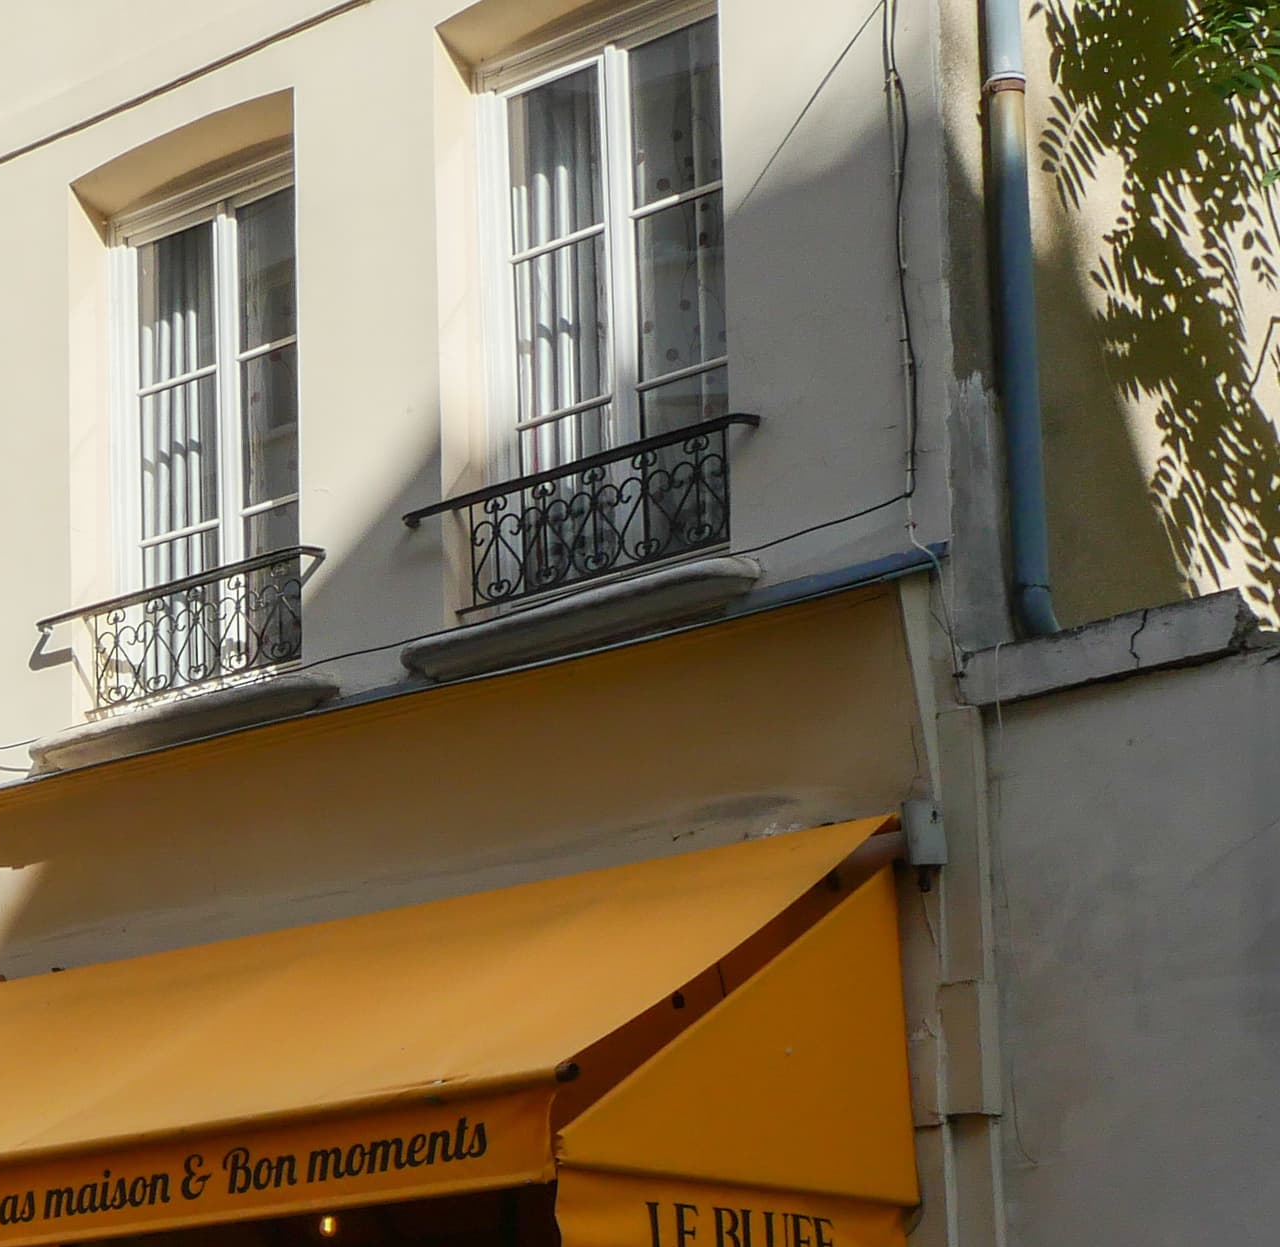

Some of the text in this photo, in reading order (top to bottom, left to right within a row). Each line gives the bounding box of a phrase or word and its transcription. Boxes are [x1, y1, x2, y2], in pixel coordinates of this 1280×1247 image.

[43, 1169, 169, 1218] maison
[181, 1154, 212, 1199] &
[223, 1147, 296, 1193] Bon
[307, 1116, 488, 1180] moments
